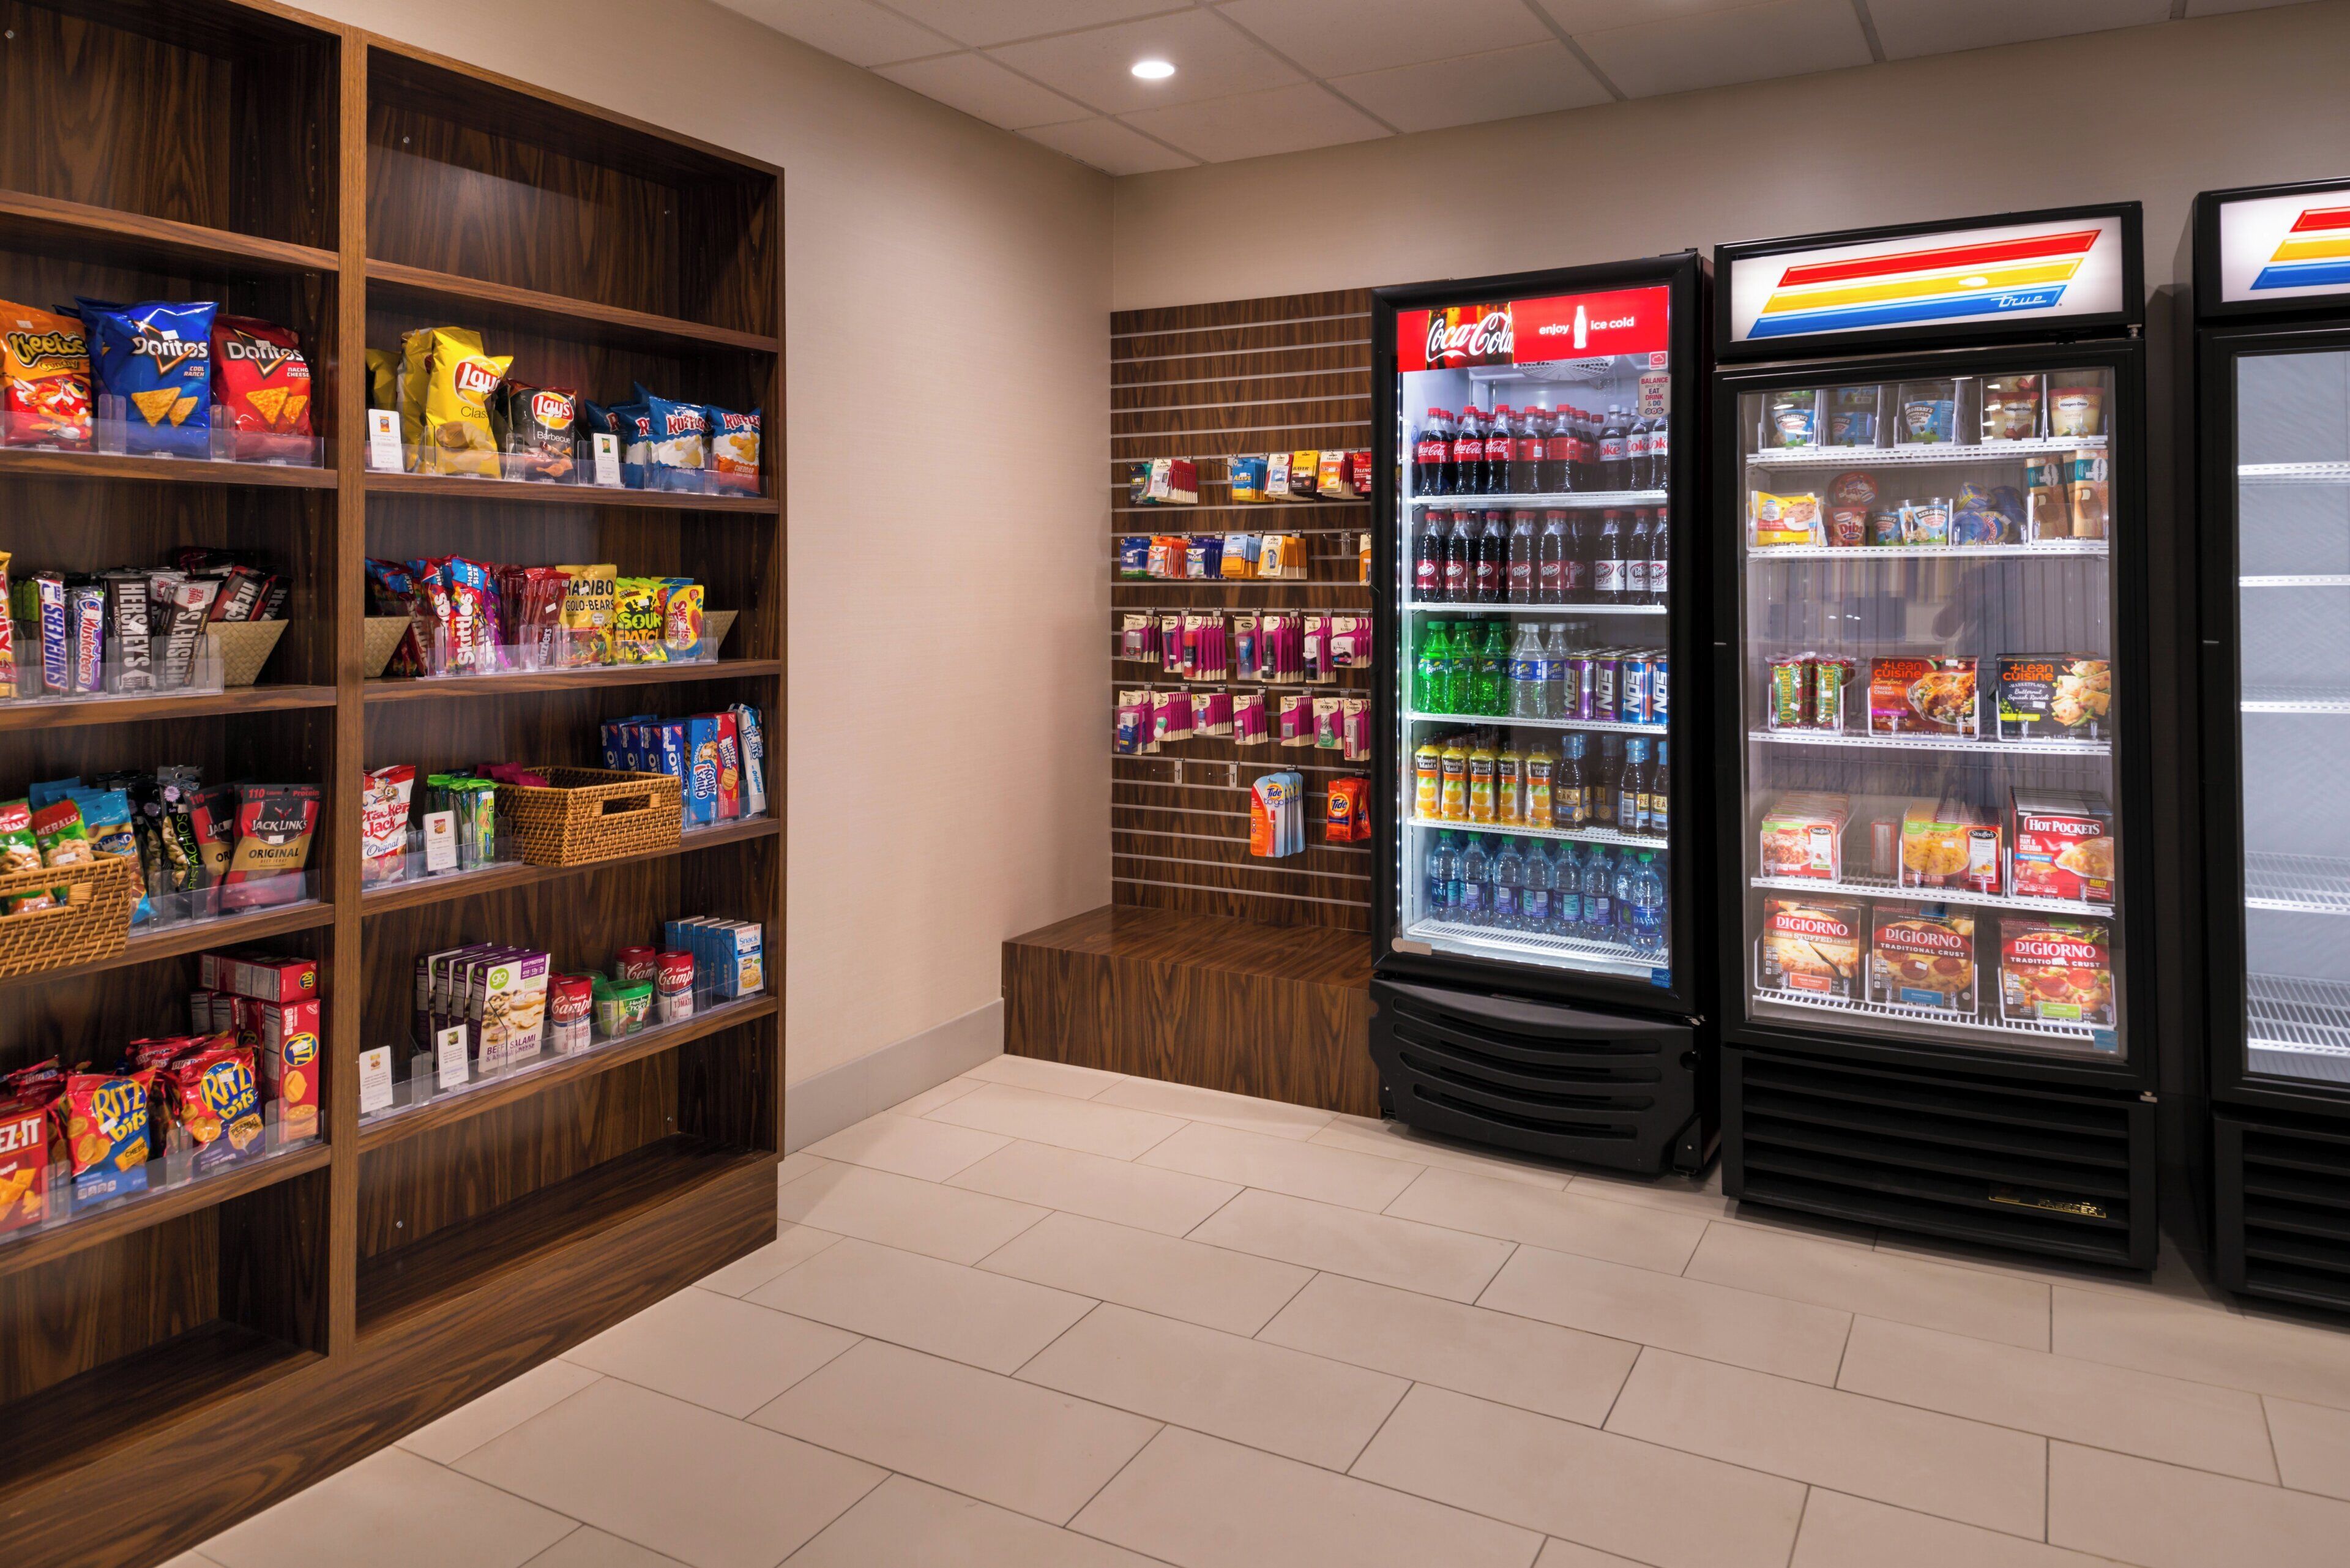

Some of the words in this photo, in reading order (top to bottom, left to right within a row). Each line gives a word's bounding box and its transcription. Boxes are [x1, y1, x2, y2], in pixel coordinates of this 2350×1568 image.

[1539, 323, 1569, 336] enjoy
[1591, 318, 1607, 330] ice
[1609, 316, 1635, 329] cold
[1427, 312, 1513, 362] Coca-Cola
[9, 332, 88, 365] Cheetos
[133, 336, 208, 357] Doritos
[226, 340, 304, 361] Doritos
[38, 359, 78, 371] Crunchy
[535, 395, 573, 419] Lay's
[537, 430, 571, 444] Barbecue
[1419, 443, 1446, 457] Coca-Cola
[1454, 441, 1483, 455] Coca-Cola
[1600, 444, 1621, 456] oke
[735, 465, 754, 475] CHEDDAR
[1418, 567, 1434, 575] Pepper
[1447, 567, 1461, 576] Pepper
[1477, 567, 1491, 576] Pepper
[1512, 567, 1529, 577] Pepper
[1542, 567, 1559, 575] Pepper
[187, 588, 196, 605] KING
[565, 600, 614, 611] GOLD-BEARS
[119, 583, 151, 667] HERSHEY'S
[456, 593, 476, 665] Skittles
[618, 612, 663, 629] SOUR
[43, 603, 67, 689] SNICKERS
[79, 617, 99, 685] Musketeers
[163, 611, 202, 684] HERSHEY'S
[1428, 664, 1445, 673] Sprite
[1481, 664, 1498, 673] Sprite
[1596, 663, 1613, 711] NOS
[1623, 664, 1640, 713] NOS
[1652, 665, 1667, 714] NOS
[1778, 669, 1792, 720] BURRITO
[693, 742, 704, 764] ORIGINAL
[695, 771, 708, 799] Chips
[752, 770, 763, 793] Original
[248, 788, 264, 798] 110
[1267, 788, 1283, 798] Tide
[1274, 797, 1285, 807] go
[1332, 799, 1348, 811] Tide
[37, 814, 77, 837] MERALD
[252, 819, 277, 832] JACK
[364, 816, 397, 837] Jack
[2029, 819, 2051, 831] HOT
[2052, 821, 2100, 835] POCKETS
[176, 813, 200, 889] PISTACHIOS
[248, 848, 299, 859] ORIGINAL
[367, 837, 399, 857] Original
[739, 935, 758, 944] Snack
[1794, 934, 1833, 943] STUFFED
[1881, 943, 1935, 955] TRADITIONAL
[2010, 957, 2069, 966] TRADITIOL
[302, 971, 314, 988] RITZ
[492, 972, 507, 986] go
[674, 998, 692, 1009] TOMATO
[487, 1043, 505, 1055] BEEF
[509, 1034, 536, 1049] SALAMI
[201, 1064, 252, 1113] RITZ
[92, 1082, 144, 1126] RITZ
[218, 1089, 256, 1120] bits
[110, 1110, 147, 1142] bits
